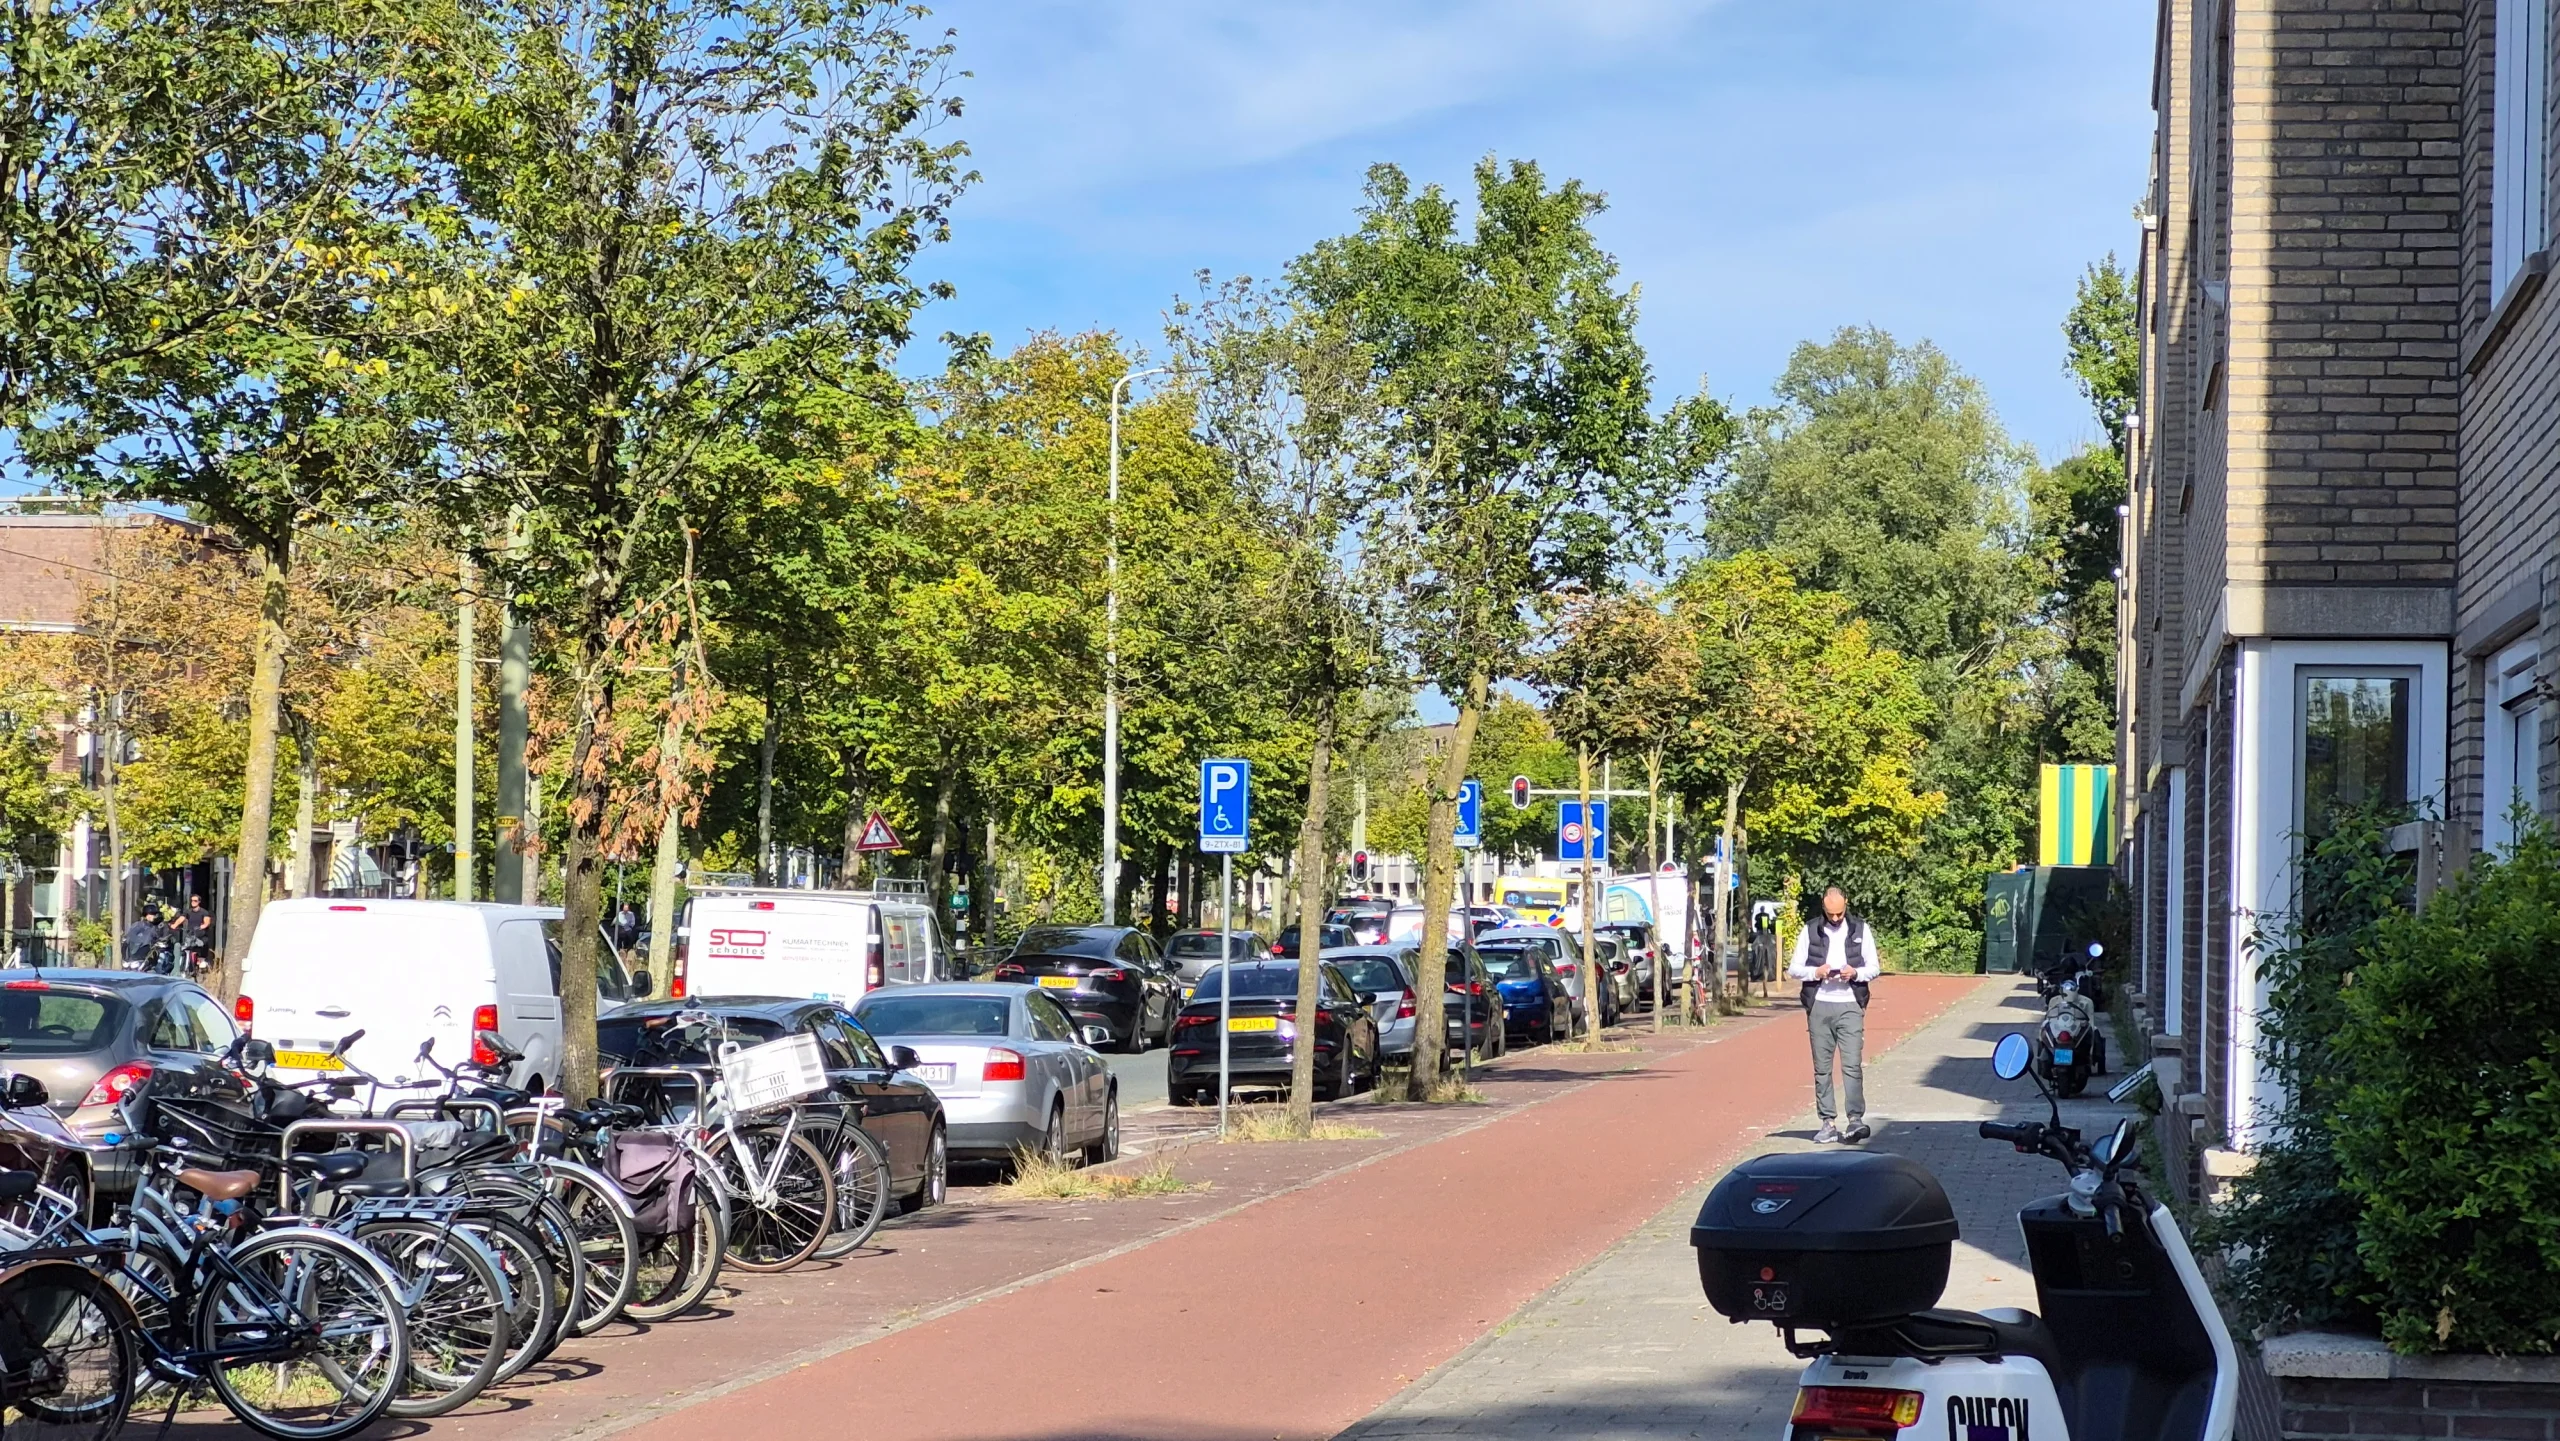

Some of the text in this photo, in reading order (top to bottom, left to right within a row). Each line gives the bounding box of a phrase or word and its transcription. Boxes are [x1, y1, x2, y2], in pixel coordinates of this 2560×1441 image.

[1210, 765, 1238, 803] P
[709, 946, 765, 955] scholtes
[1232, 1020, 1270, 1029] P-931-LT
